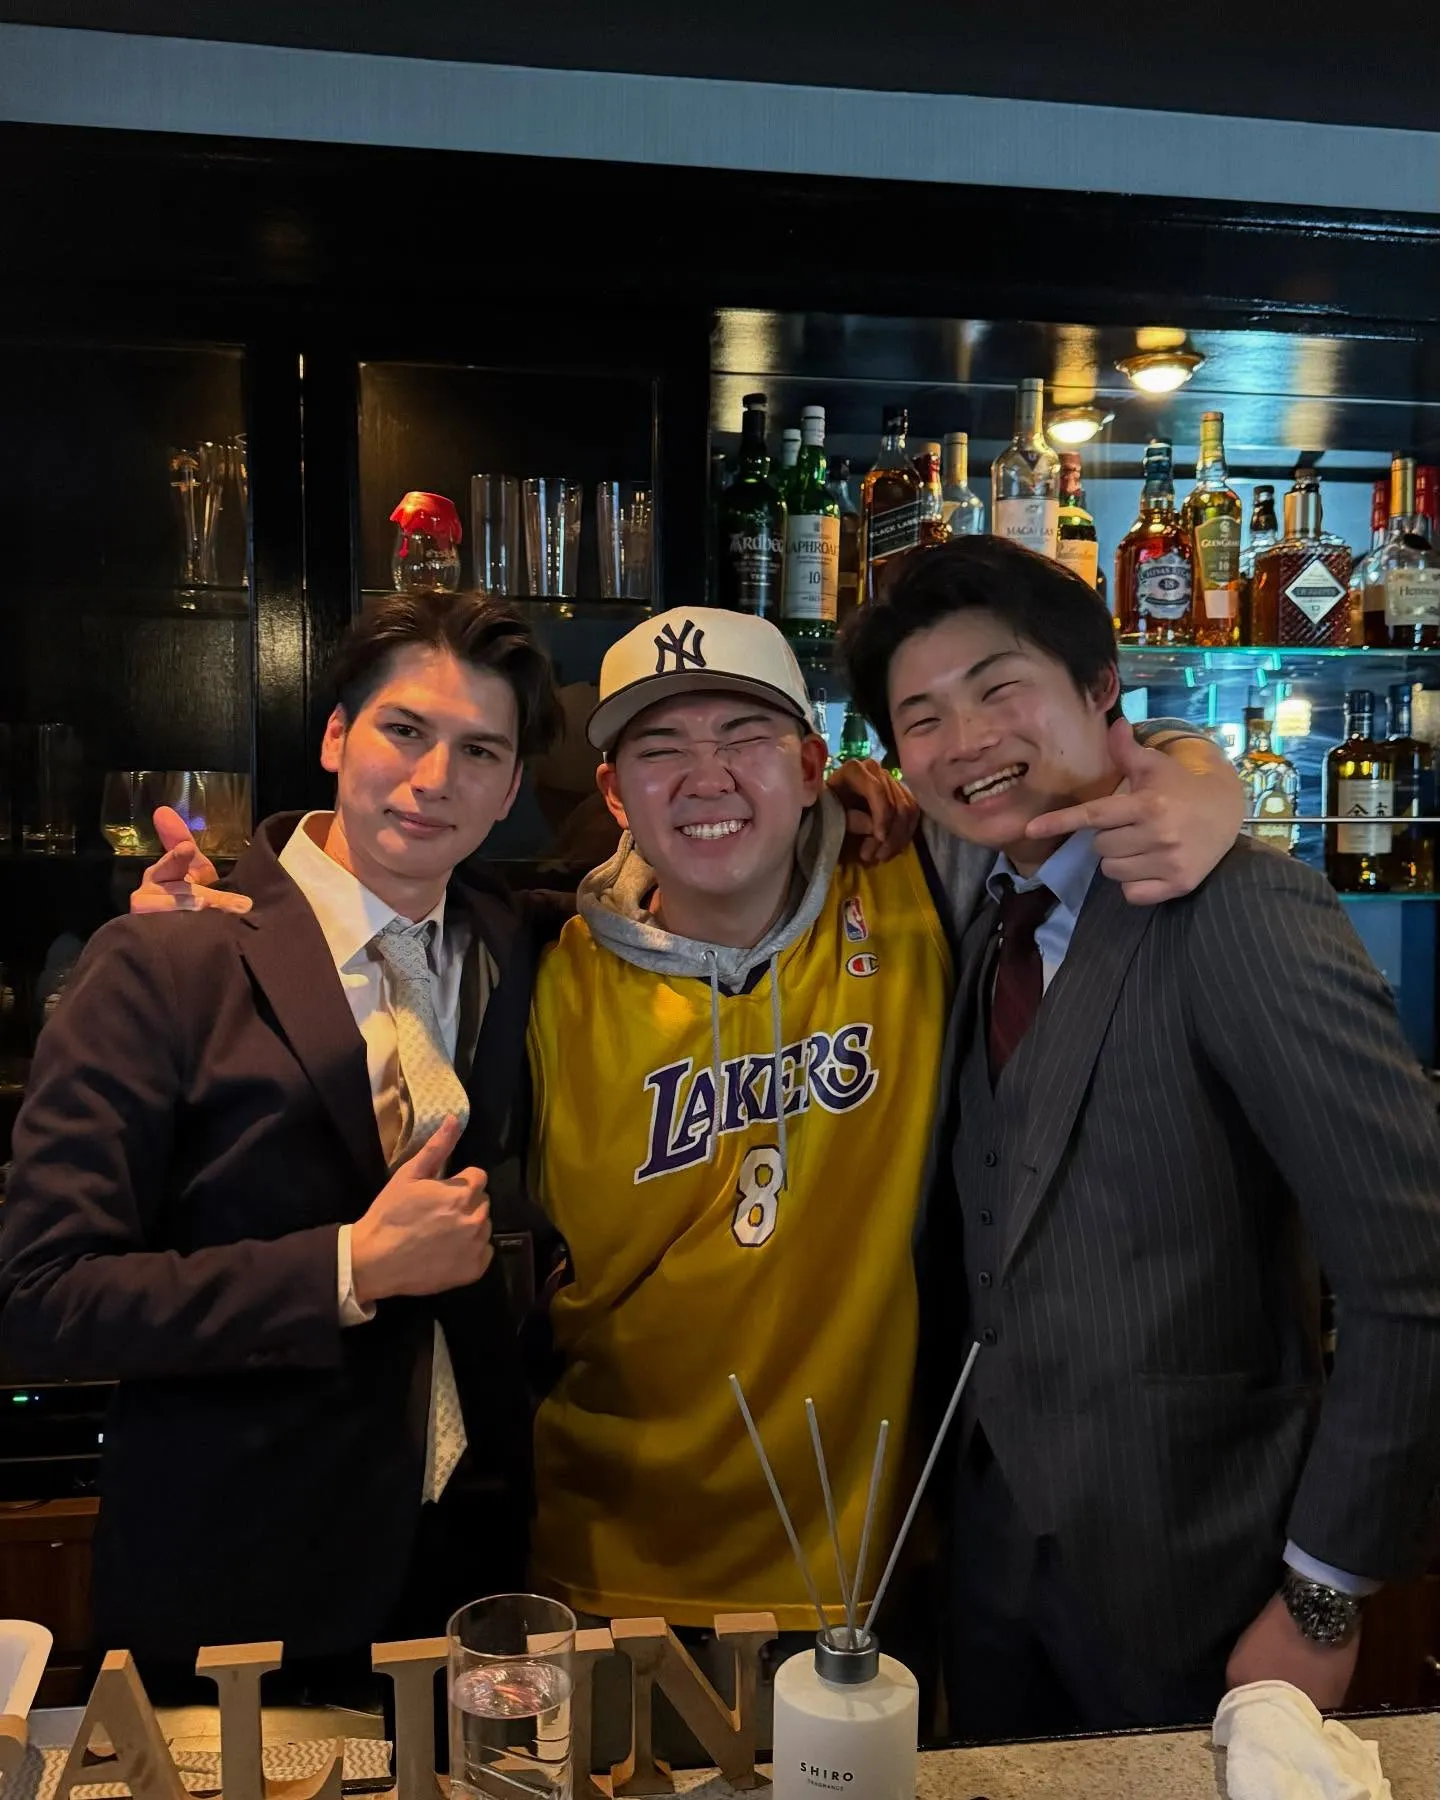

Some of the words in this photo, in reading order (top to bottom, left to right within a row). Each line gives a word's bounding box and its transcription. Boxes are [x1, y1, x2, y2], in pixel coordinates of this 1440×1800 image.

[809, 571, 821, 584] 10
[1164, 579, 1175, 589] 18
[634, 1023, 880, 1184] LAKERS
[731, 1144, 784, 1248] 8
[800, 1761, 854, 1782] SHIRO
